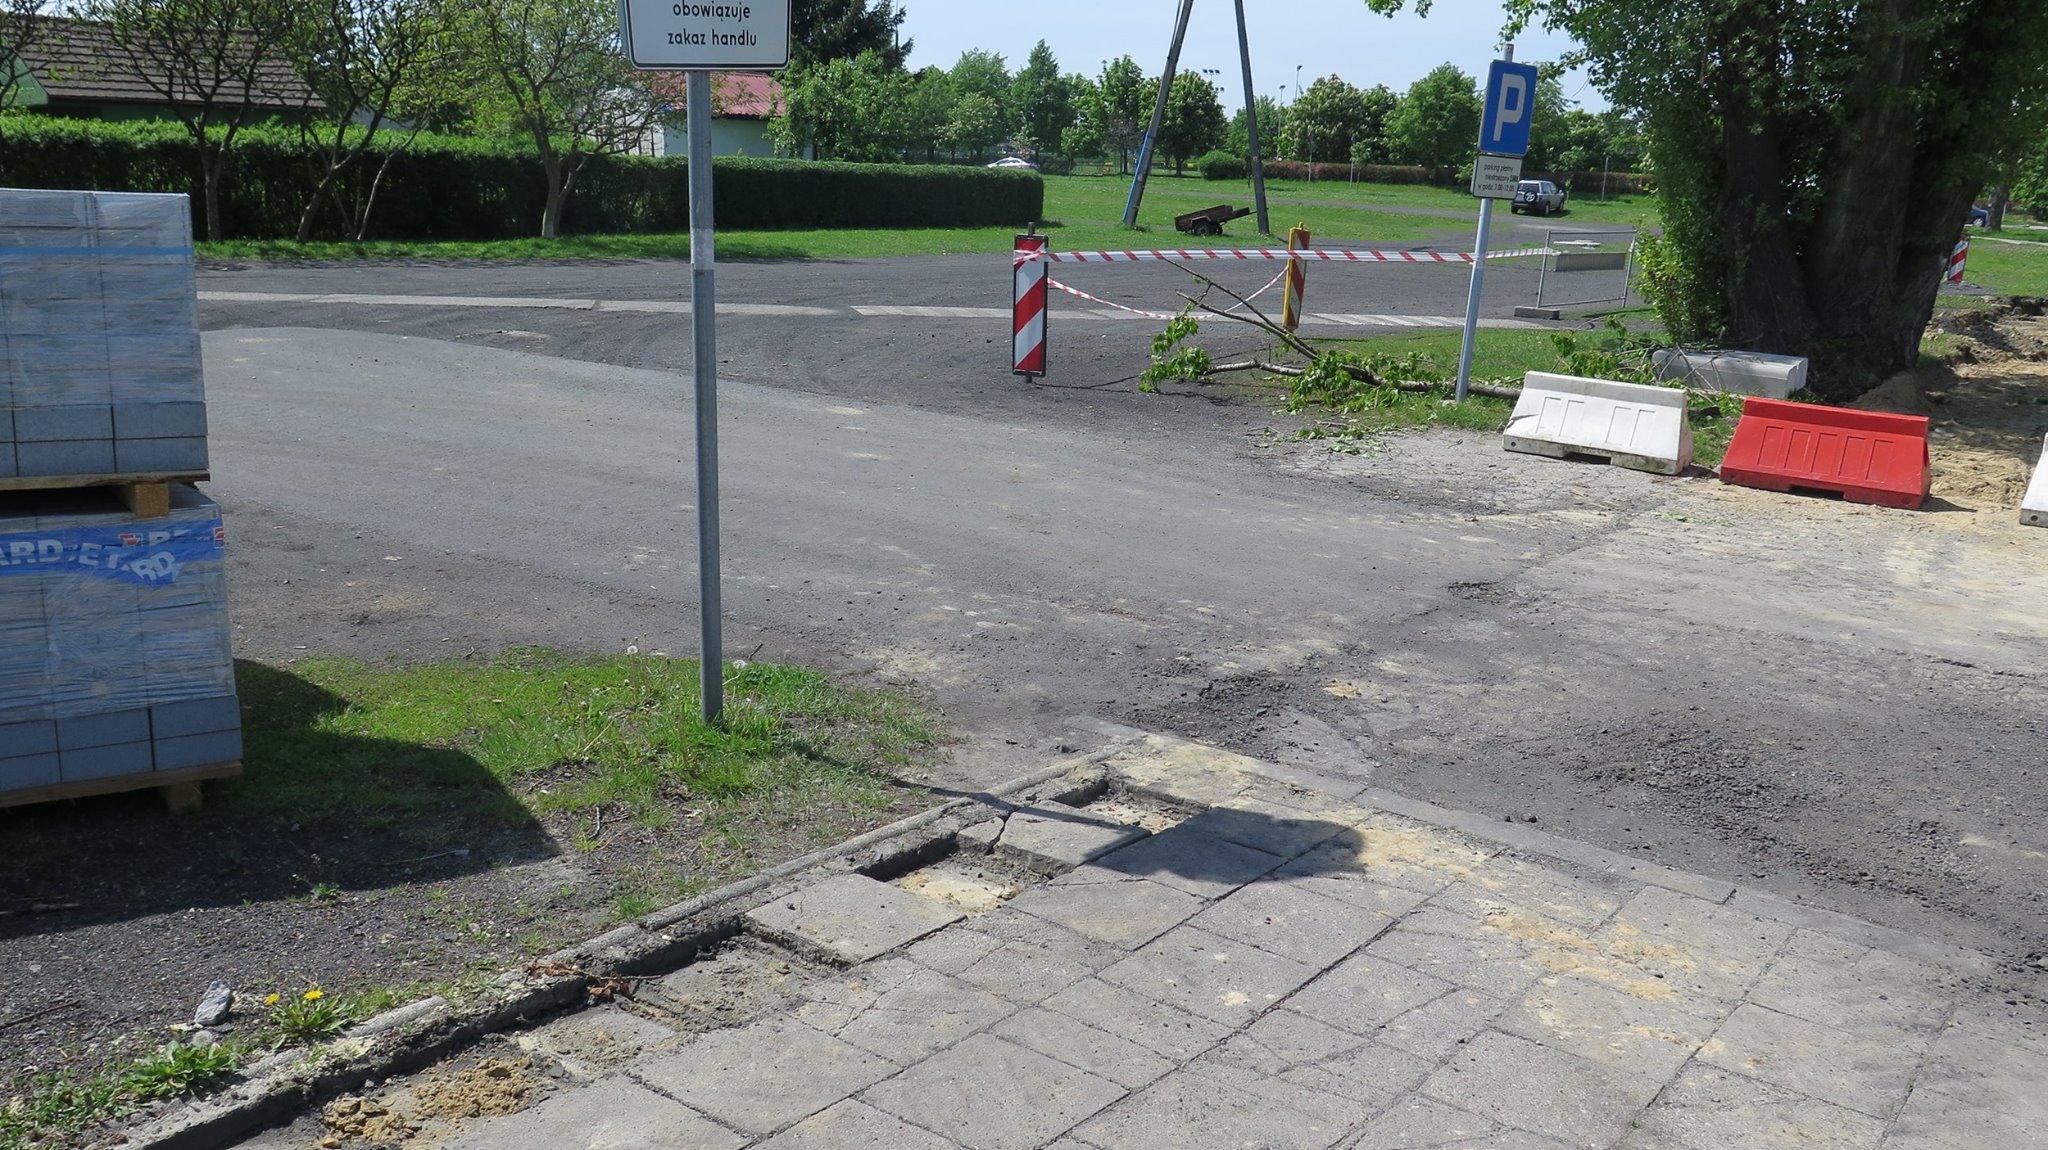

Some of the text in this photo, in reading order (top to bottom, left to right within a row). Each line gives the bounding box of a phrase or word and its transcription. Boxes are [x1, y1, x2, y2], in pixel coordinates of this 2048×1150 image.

[672, 0, 751, 22] obowiązuje
[667, 28, 757, 47] zakaz handlu
[1492, 72, 1527, 142] P
